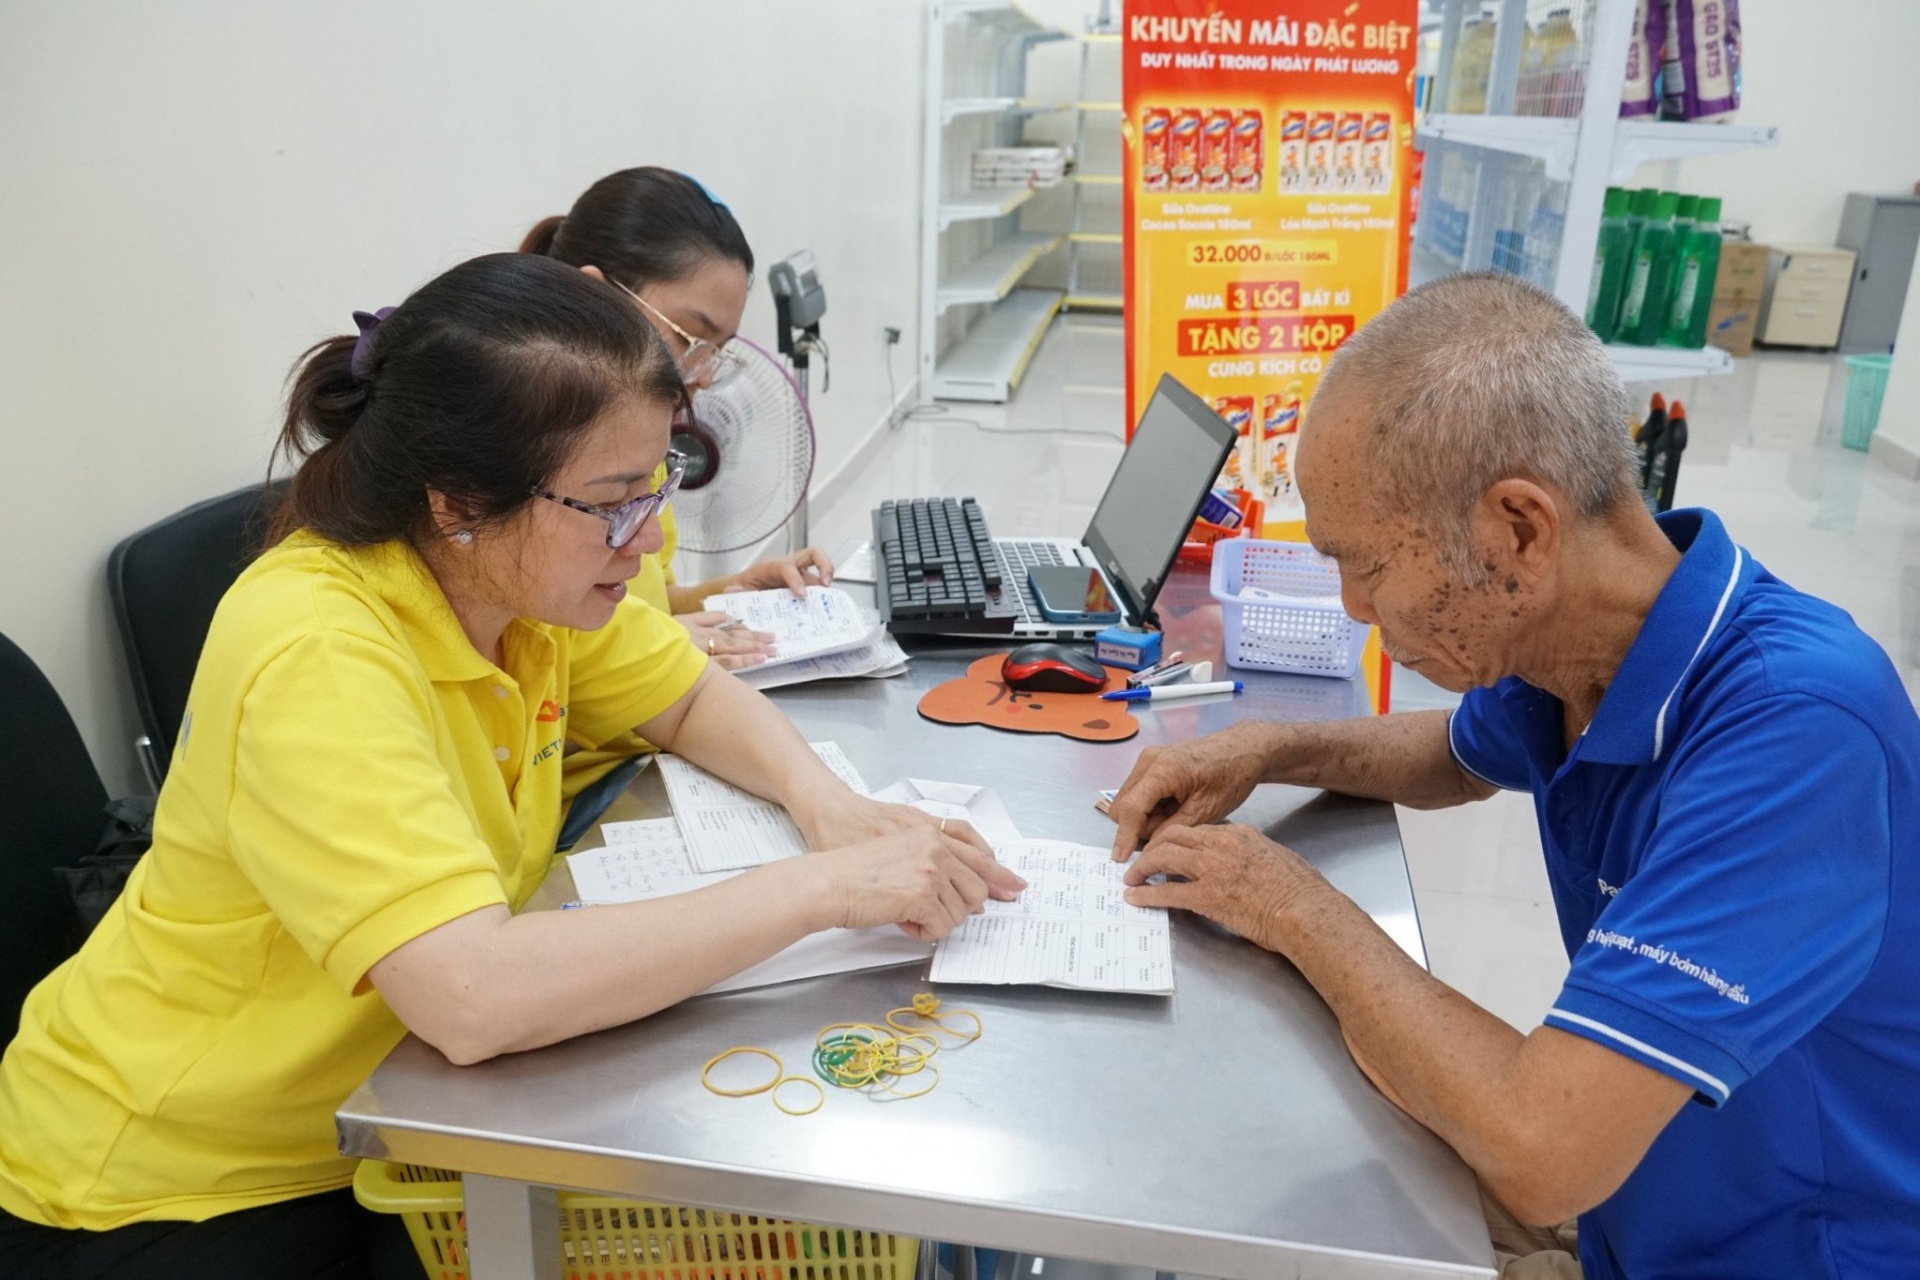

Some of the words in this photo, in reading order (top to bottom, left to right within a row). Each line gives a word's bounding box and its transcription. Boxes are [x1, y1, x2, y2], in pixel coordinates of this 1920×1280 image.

[1131, 10, 1242, 44] KHUYẾN
[1249, 15, 1299, 46] MÃI
[1305, 18, 1357, 52] ĐẶC
[1363, 19, 1412, 54] BIỆT
[1141, 52, 1172, 68] DUY
[1175, 50, 1216, 69] NHẤT
[1218, 54, 1269, 71] TRONG
[1270, 53, 1312, 72] NGÀY
[1314, 54, 1350, 73] PHÁT
[1351, 58, 1400, 75] LƯƠNG
[1704, 40, 1721, 78] ST25
[1193, 245, 1262, 263] 32.000
[1185, 293, 1224, 310] MUA
[1233, 288, 1247, 309] 3
[1253, 282, 1294, 309] LỐC
[1301, 286, 1332, 308] BẤT
[1188, 322, 1261, 355] TẶNG
[1268, 324, 1285, 349] 2
[1292, 319, 1345, 352] HỘP
[1208, 357, 1255, 378] CÙNG
[1259, 355, 1296, 375] KÍCH
[1639, 944, 1670, 964] máy
[1668, 951, 1700, 977] bơm
[1699, 967, 1730, 996] hàng
